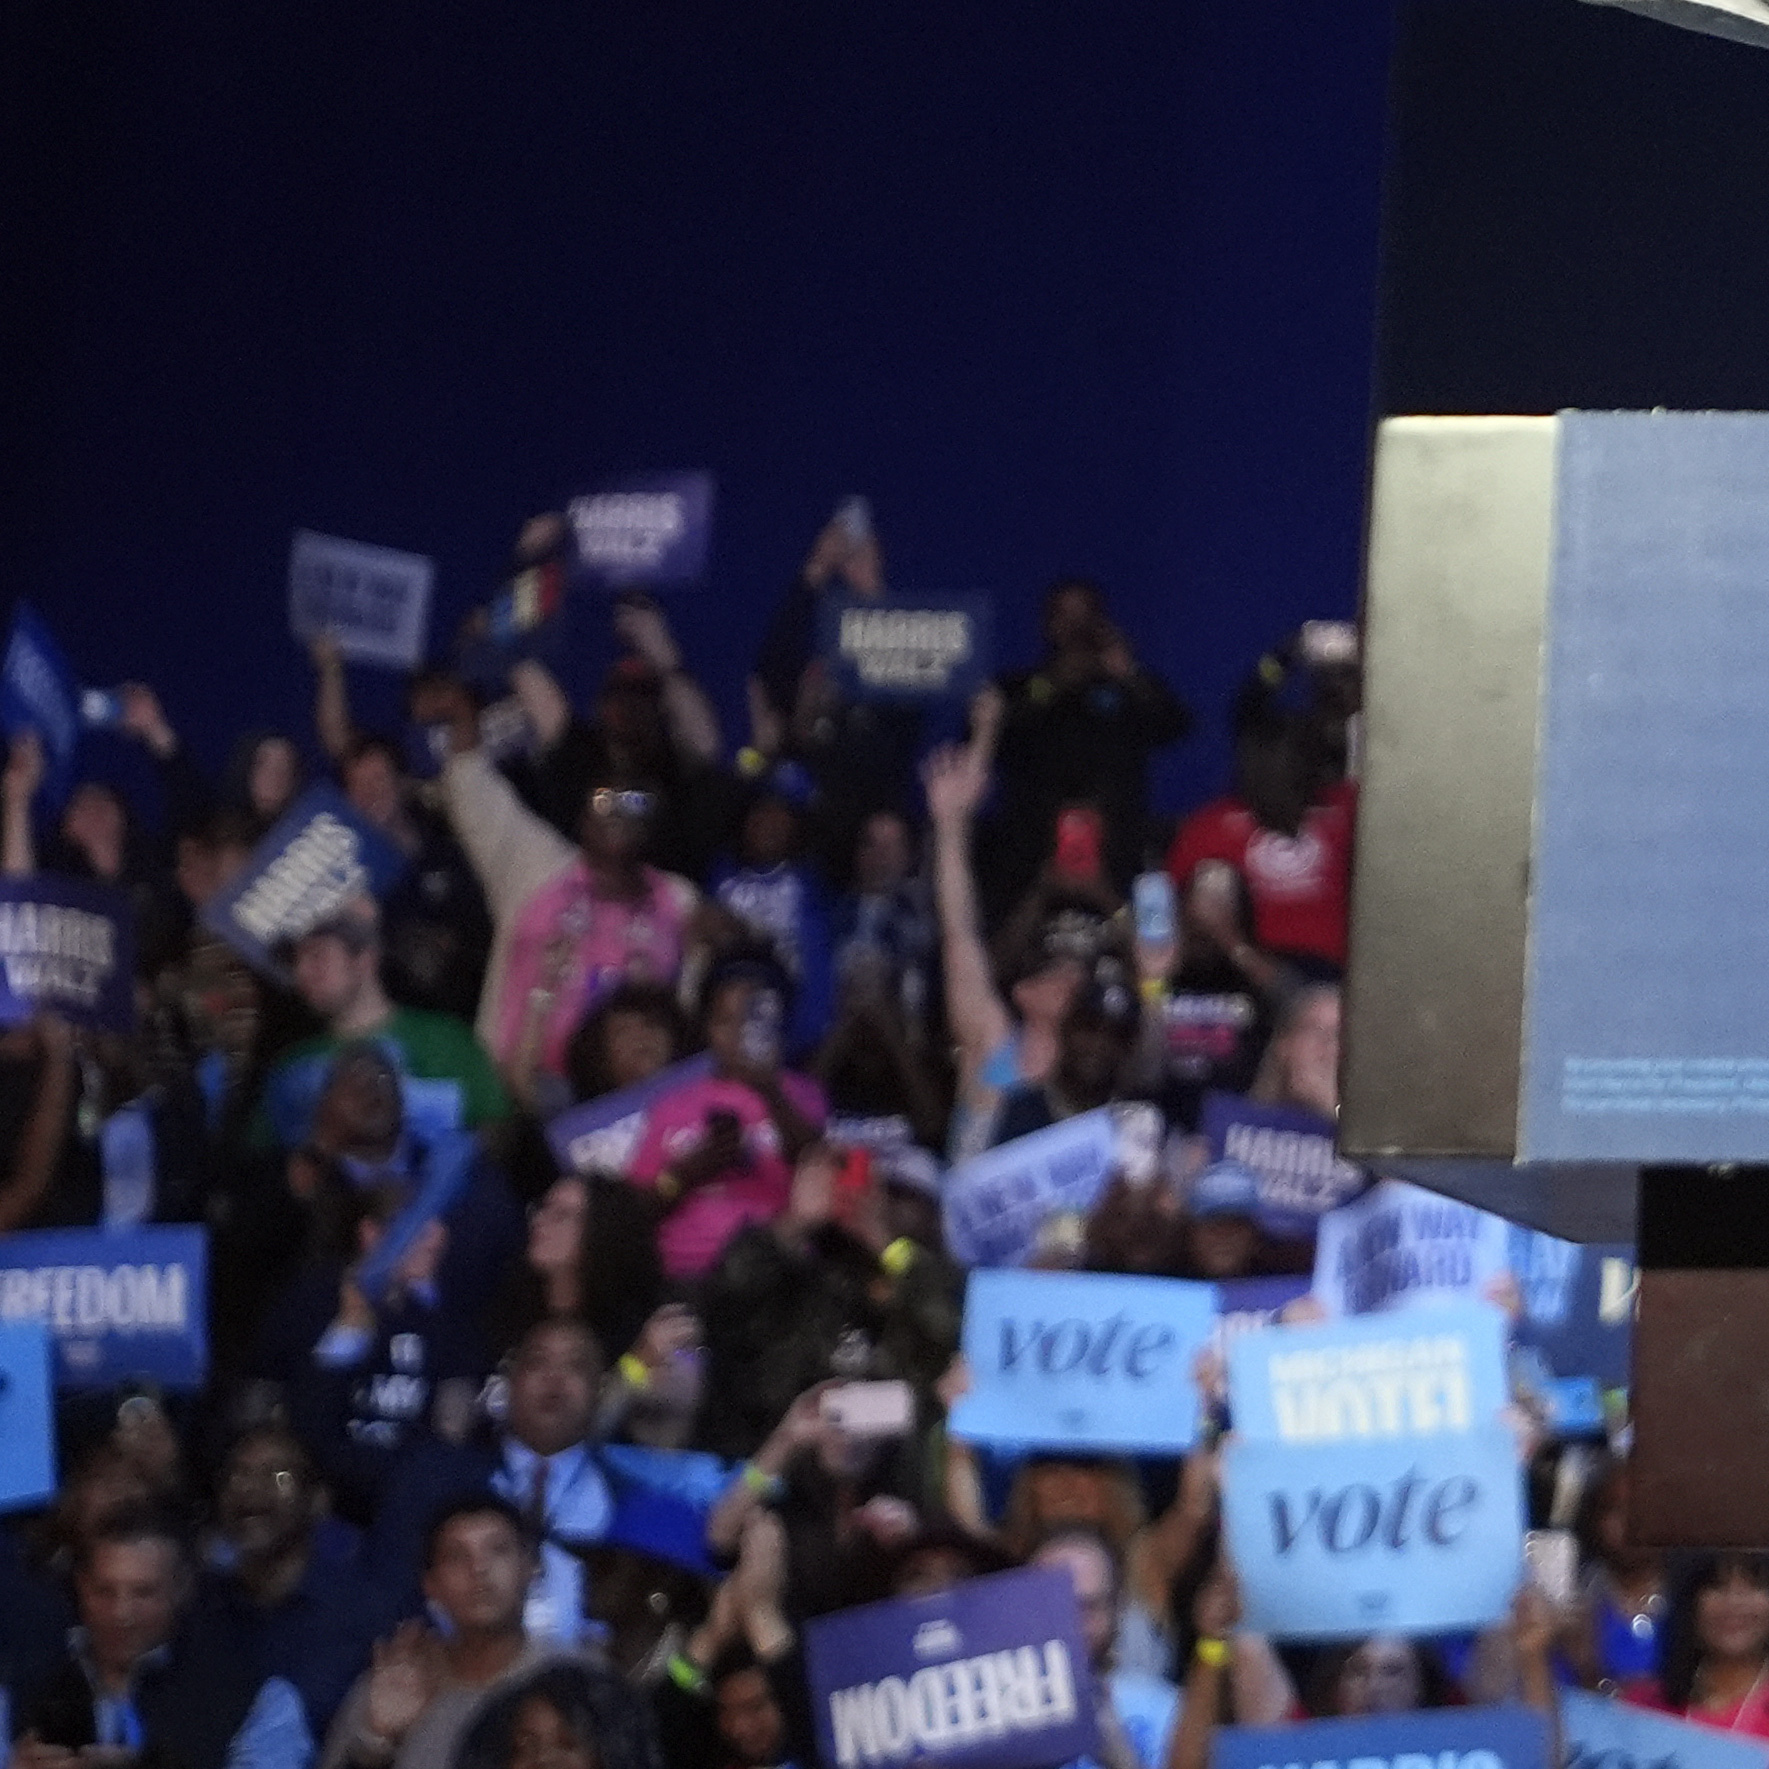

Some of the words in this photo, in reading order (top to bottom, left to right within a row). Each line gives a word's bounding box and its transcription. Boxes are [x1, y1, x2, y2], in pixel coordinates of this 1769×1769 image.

[1224, 1123, 1334, 1178] HARRI
[1000, 1306, 1178, 1379] vote
[1267, 1464, 1478, 1556] vote
[829, 1639, 1078, 1769] FREEDOM
